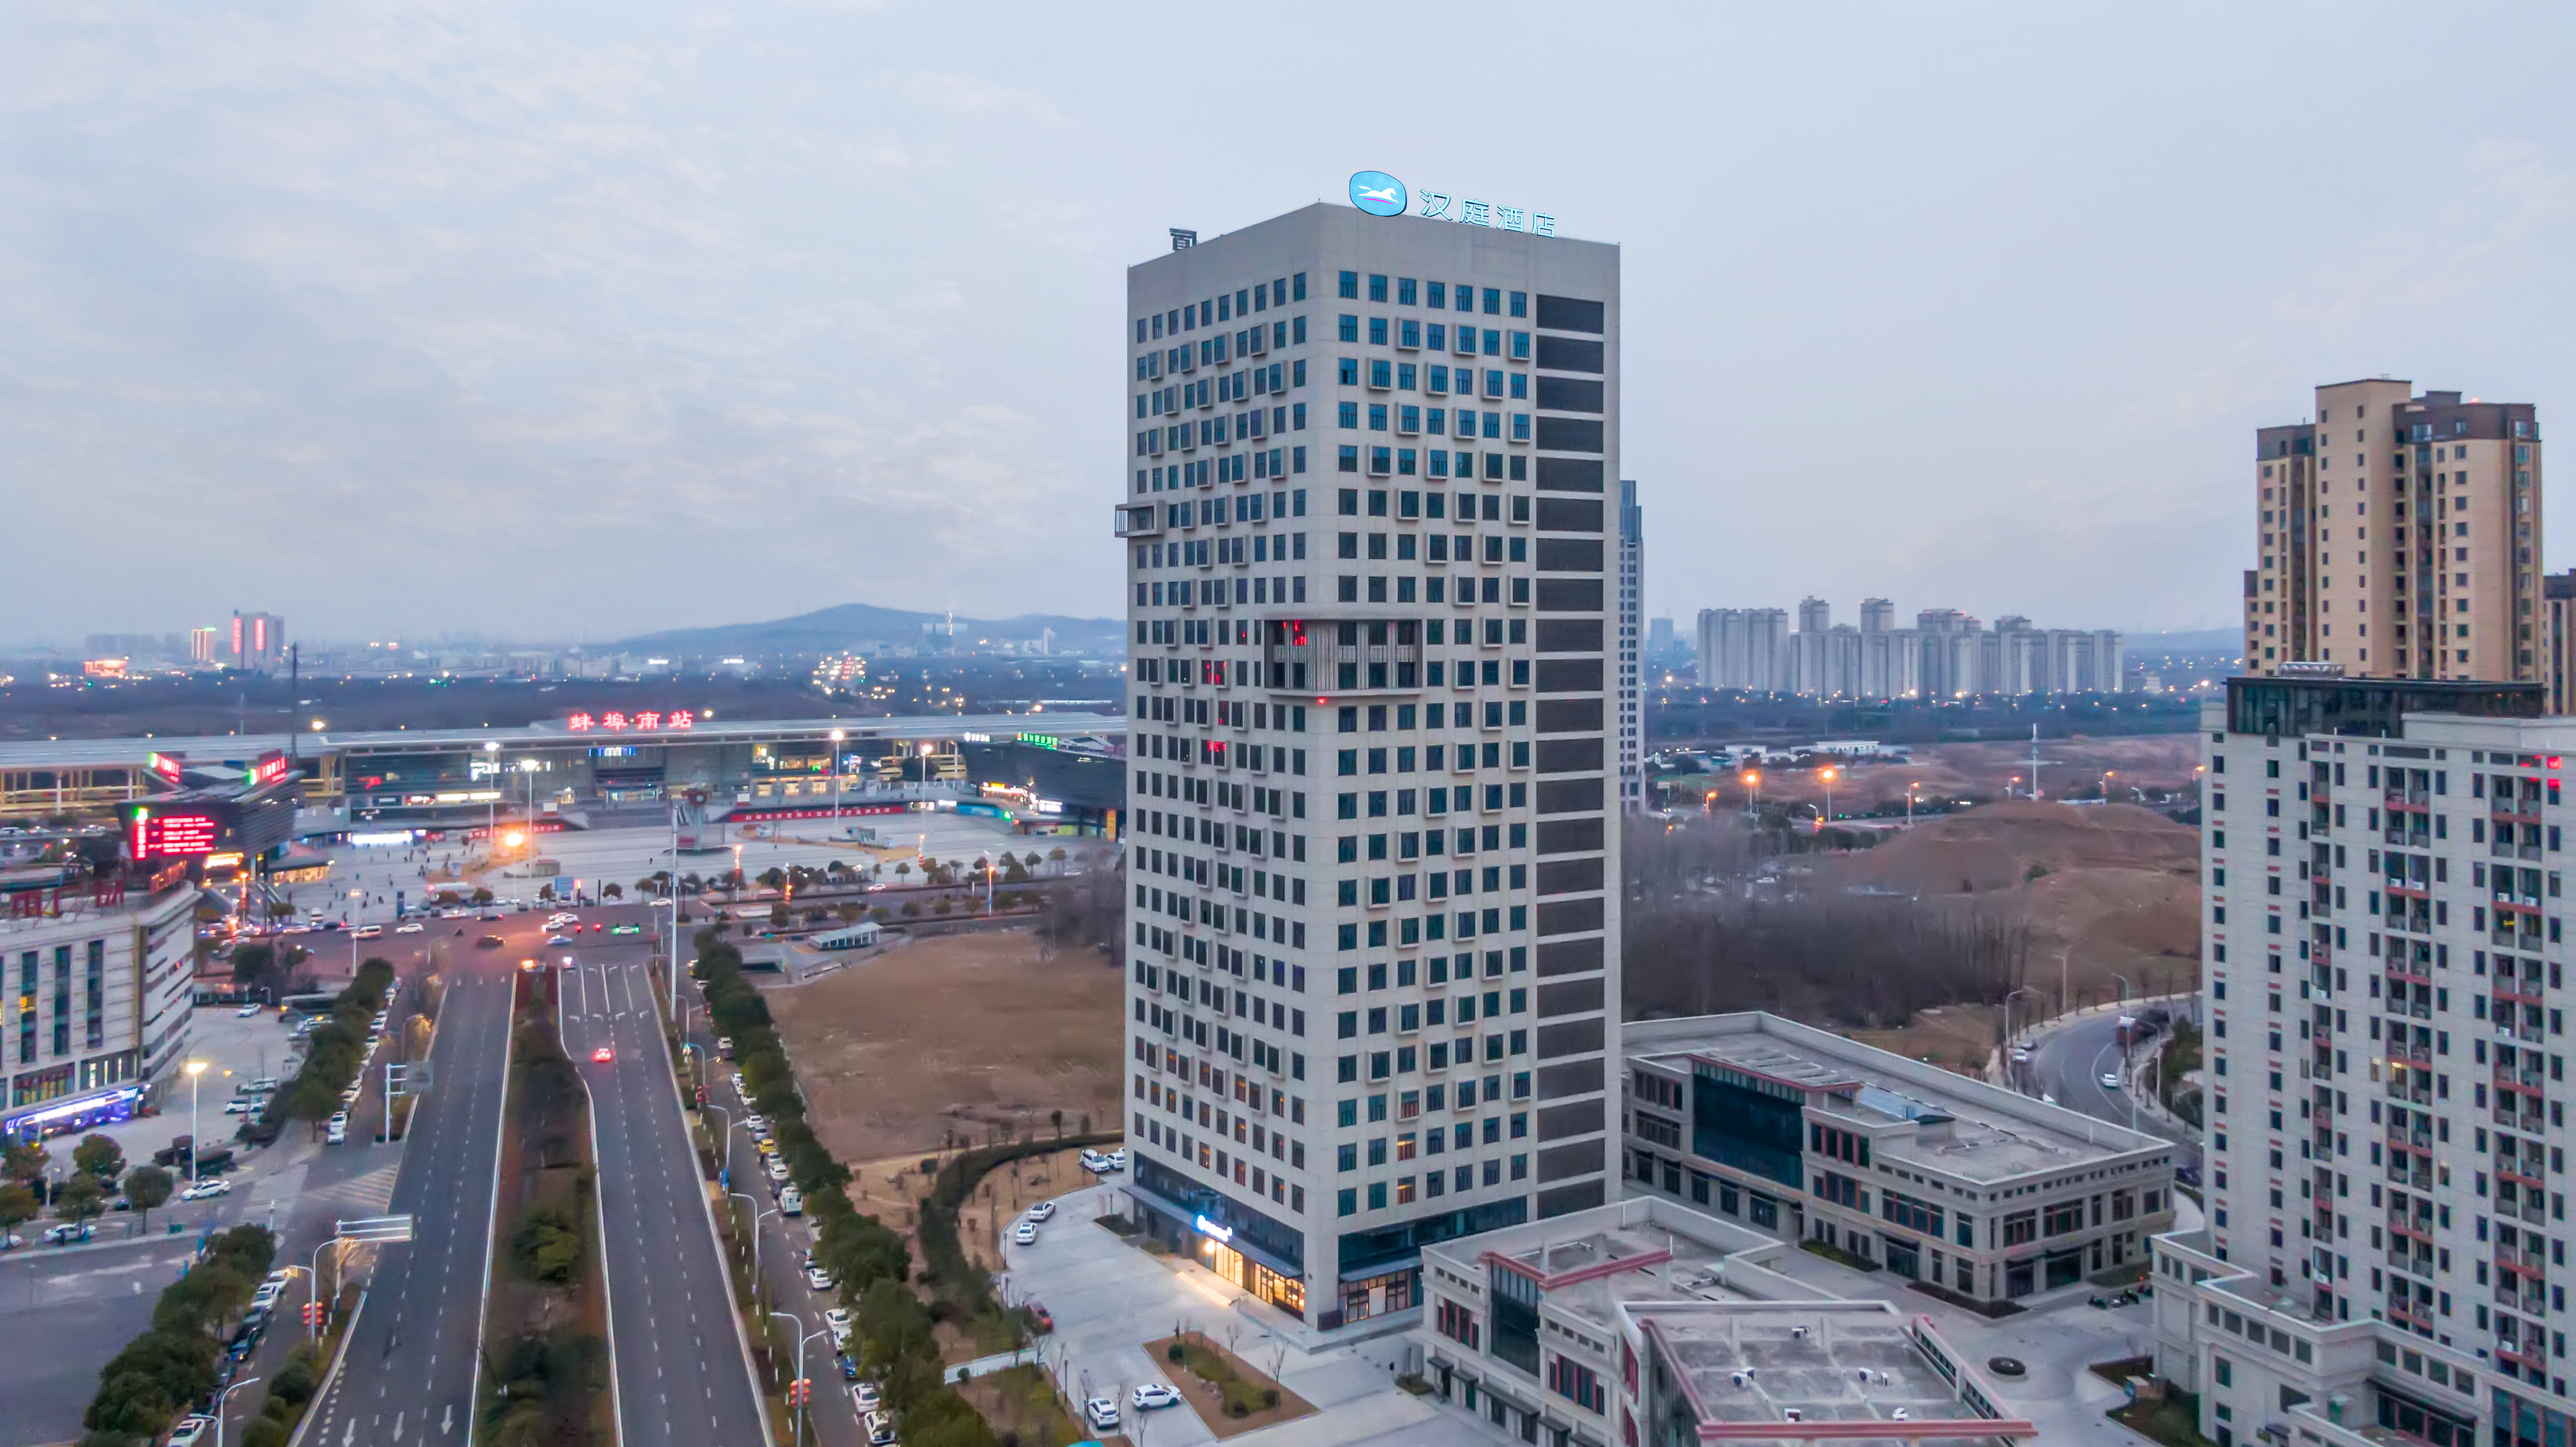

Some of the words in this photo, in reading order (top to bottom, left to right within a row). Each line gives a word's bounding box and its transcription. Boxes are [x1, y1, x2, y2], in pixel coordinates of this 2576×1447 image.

[1420, 188, 1555, 238] 汉庭酒店
[569, 711, 694, 731] 蚌埠南站
